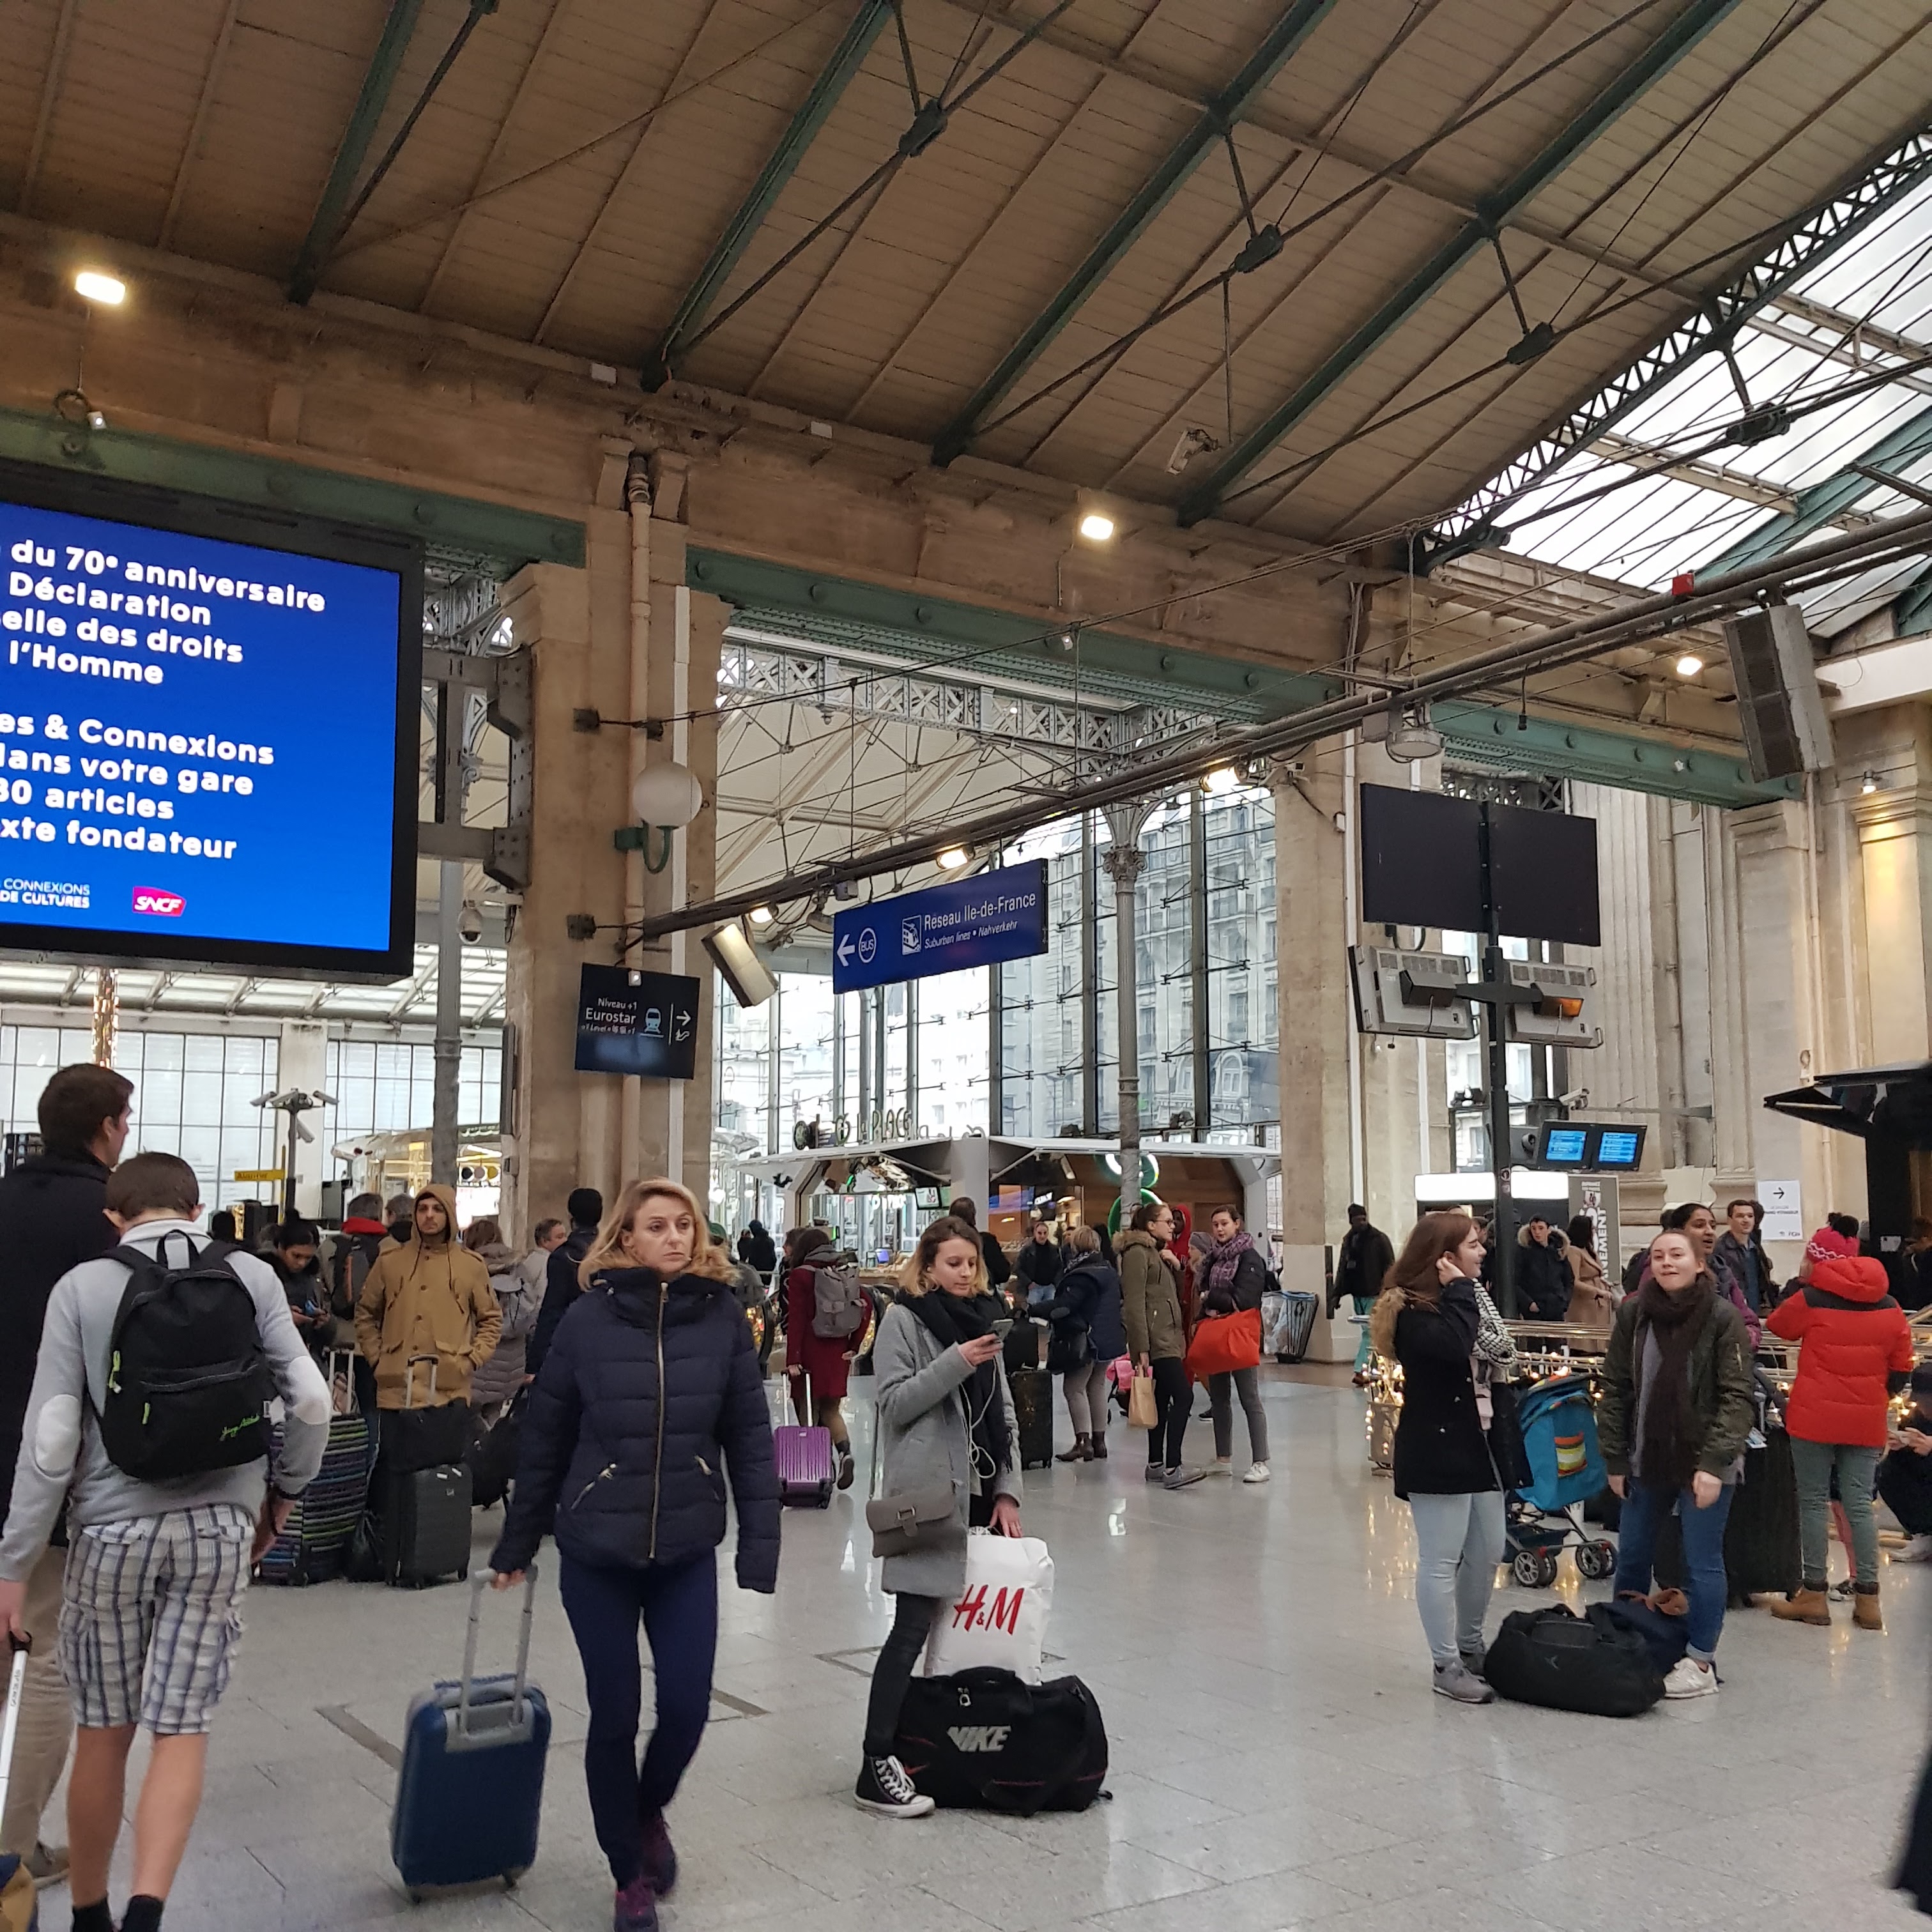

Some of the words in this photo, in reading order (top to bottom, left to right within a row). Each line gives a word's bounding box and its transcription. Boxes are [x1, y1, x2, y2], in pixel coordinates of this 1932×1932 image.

[11, 539, 56, 567] du
[125, 562, 325, 612] anniversaire
[9, 571, 211, 626] Déclaration
[0, 608, 67, 637] elle
[76, 617, 137, 647] des
[146, 628, 243, 663] droits
[44, 714, 70, 740] &
[79, 719, 274, 765] Connexions
[0, 742, 71, 774] ans
[80, 757, 168, 786] votre
[177, 769, 254, 795] gare
[45, 788, 174, 820] articles
[66, 820, 237, 859] fondateur
[3, 878, 90, 896] CONNEXIONS
[22, 891, 90, 908] CULTURES
[134, 896, 182, 912] SNCF
[924, 912, 961, 931] Réseau
[964, 893, 1036, 922] Ile-de-France
[861, 939, 874, 952] BUS
[924, 934, 954, 949] Suburban
[956, 931, 971, 942] lines
[978, 920, 1018, 937] Nahverkehr
[585, 1007, 636, 1025] Eurostar
[597, 997, 626, 1009] Niveau
[952, 1584, 1025, 1636] H&M
[947, 1726, 1012, 1752] NIKE
